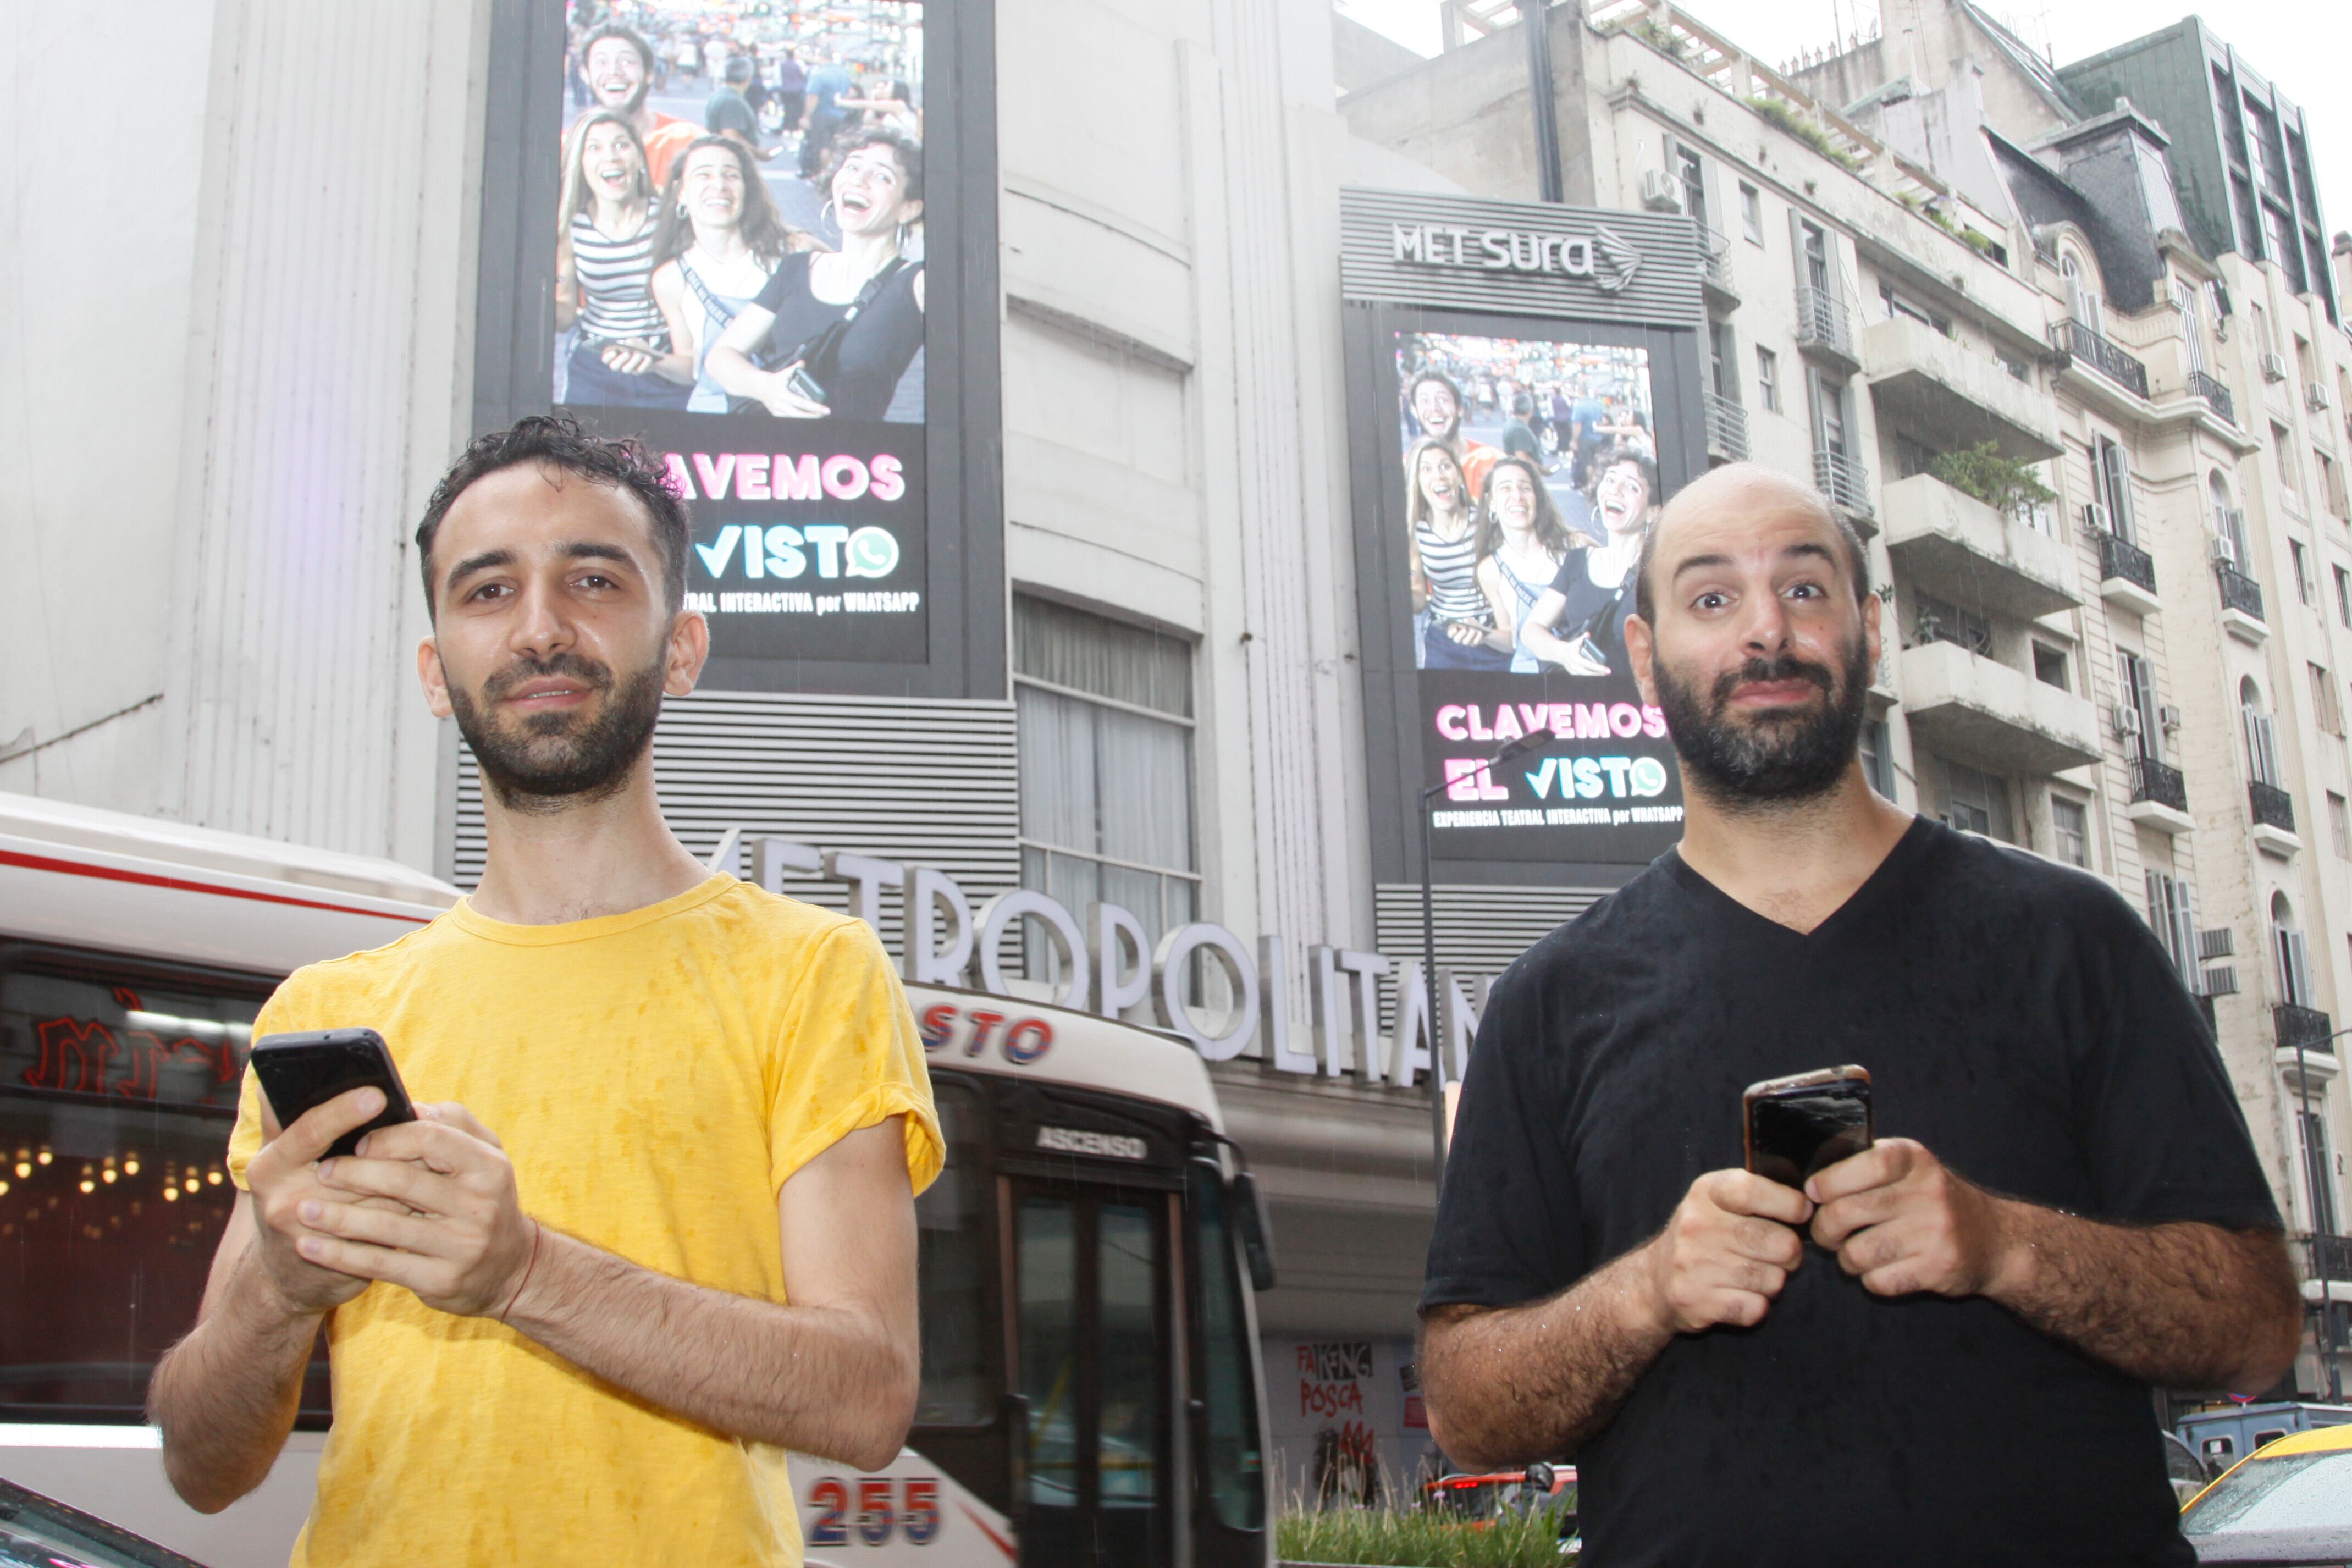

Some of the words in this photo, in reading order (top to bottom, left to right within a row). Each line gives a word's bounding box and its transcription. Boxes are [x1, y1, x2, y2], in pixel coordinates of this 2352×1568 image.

[1392, 221, 1469, 265] MET
[664, 452, 906, 501] AVEMOS
[720, 592, 814, 614] INTERACTIVA
[816, 594, 841, 616] por
[843, 590, 920, 612] WHATSAPP
[1436, 703, 1667, 741] CLAVEMOS
[1444, 759, 1509, 802] EL
[1432, 810, 1500, 828] EXPERIENCIA
[1500, 809, 1545, 826] TEATRAL
[1546, 808, 1611, 825] INTERACTIVA
[1613, 810, 1630, 826] por
[1631, 806, 1683, 823] WHATSAPP
[1035, 1126, 1147, 1160] ASCENSO
[807, 1476, 941, 1548] 255
